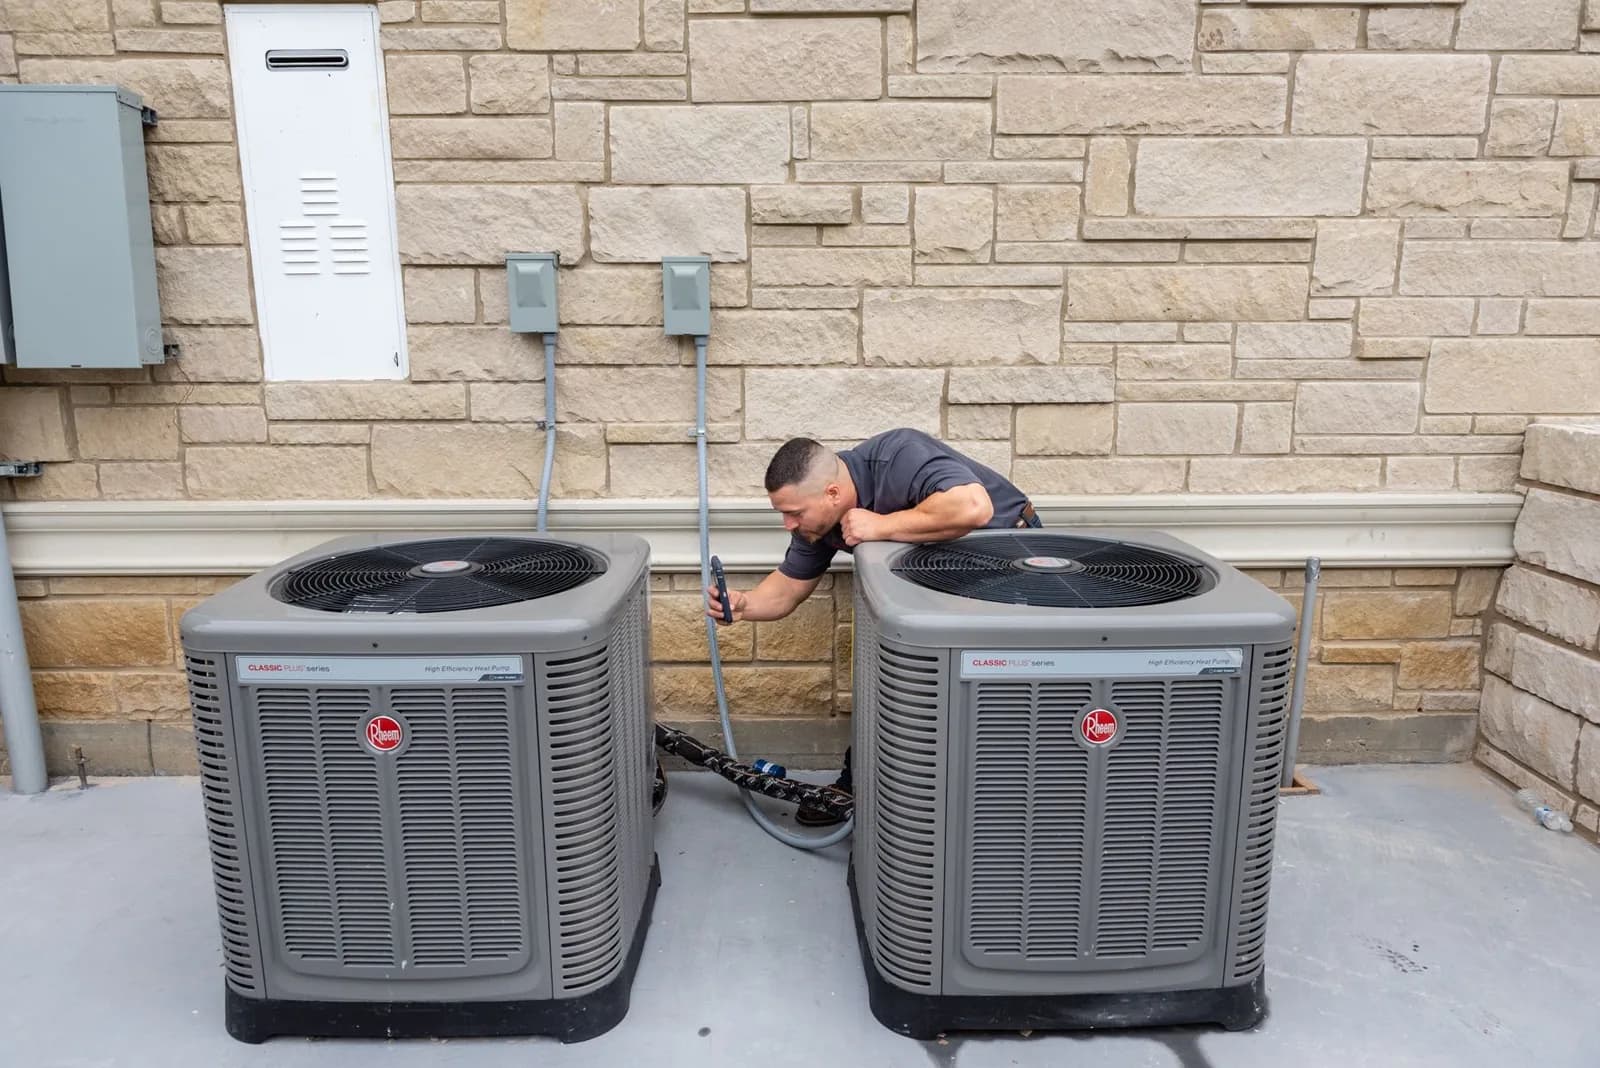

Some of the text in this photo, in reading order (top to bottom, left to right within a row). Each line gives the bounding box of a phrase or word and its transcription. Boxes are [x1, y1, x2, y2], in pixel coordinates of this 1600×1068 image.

[972, 659, 1007, 667] CLASSIC
[1148, 658, 1163, 667] High
[1195, 658, 1211, 666] Heat
[248, 664, 283, 672] CLASSIC
[306, 665, 330, 673] series
[425, 665, 441, 673] High
[441, 665, 473, 673] Efficiency
[474, 664, 490, 672] Heat
[1086, 712, 1115, 739] Rheem
[370, 719, 400, 746] Rheem
